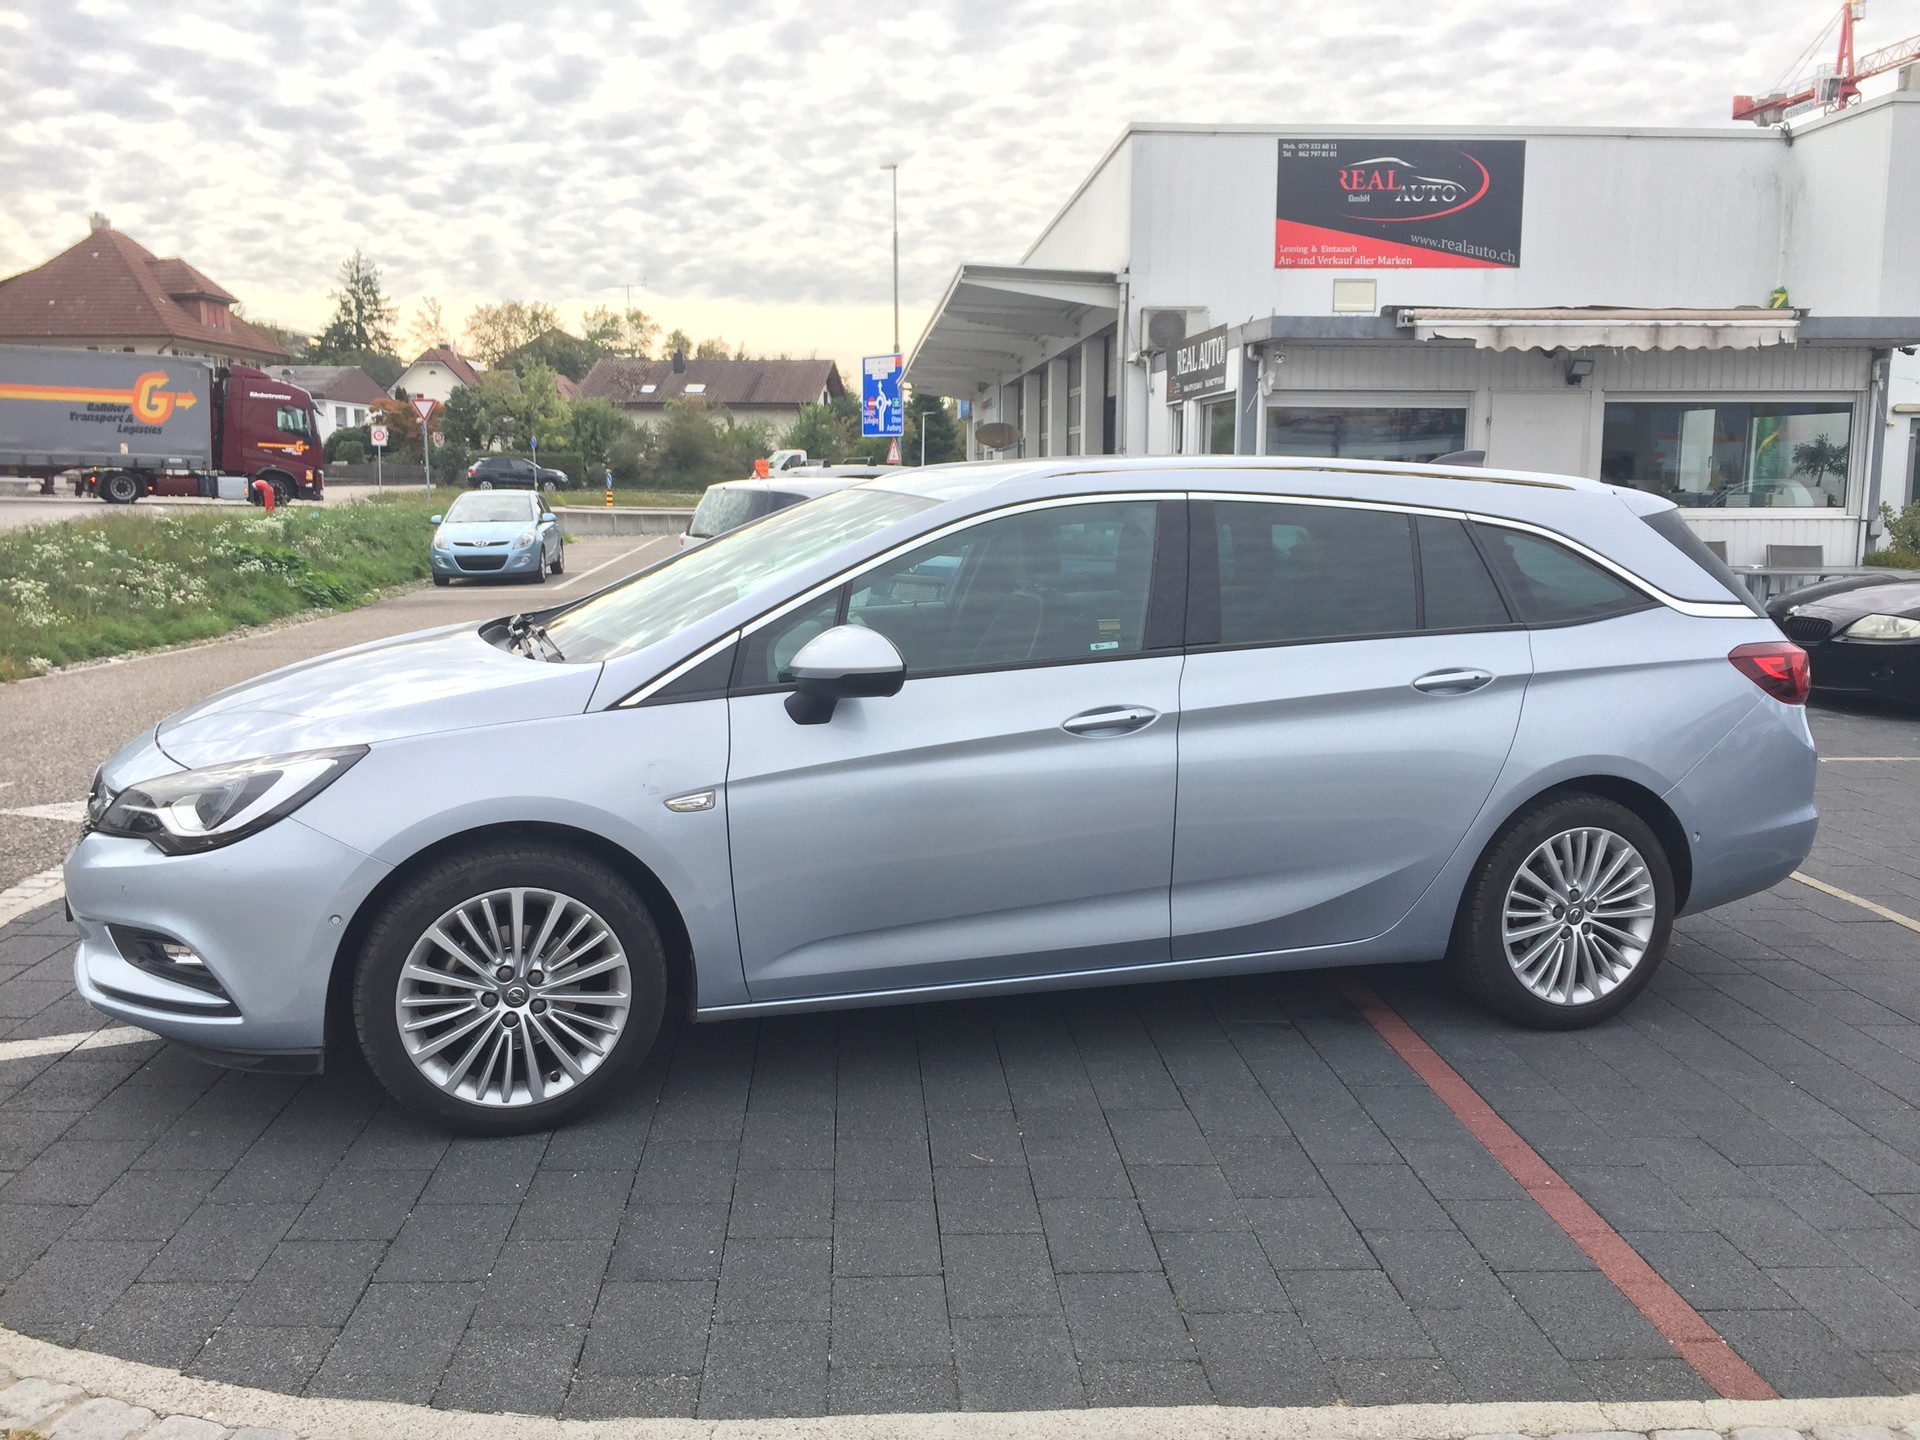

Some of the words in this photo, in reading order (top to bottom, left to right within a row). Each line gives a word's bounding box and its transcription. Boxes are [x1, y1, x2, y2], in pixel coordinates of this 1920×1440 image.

[1338, 169, 1401, 191] REAL
[1348, 194, 1370, 203] GmbH
[1395, 184, 1458, 202] AUTO
[1279, 245, 1308, 255] Leasing
[1311, 245, 1318, 253] &
[1321, 245, 1357, 253] Eintausch
[1410, 234, 1516, 263] www.realauto.ch
[1279, 256, 1295, 265] An-
[1297, 256, 1315, 265] und
[1317, 255, 1353, 265] Verkauf
[1354, 256, 1375, 265] aller
[1377, 256, 1412, 265] Marken
[1177, 345, 1198, 375] REAL
[1198, 336, 1223, 370] AUTO
[69, 411, 124, 423] Transport
[117, 425, 163, 435] Logistics
